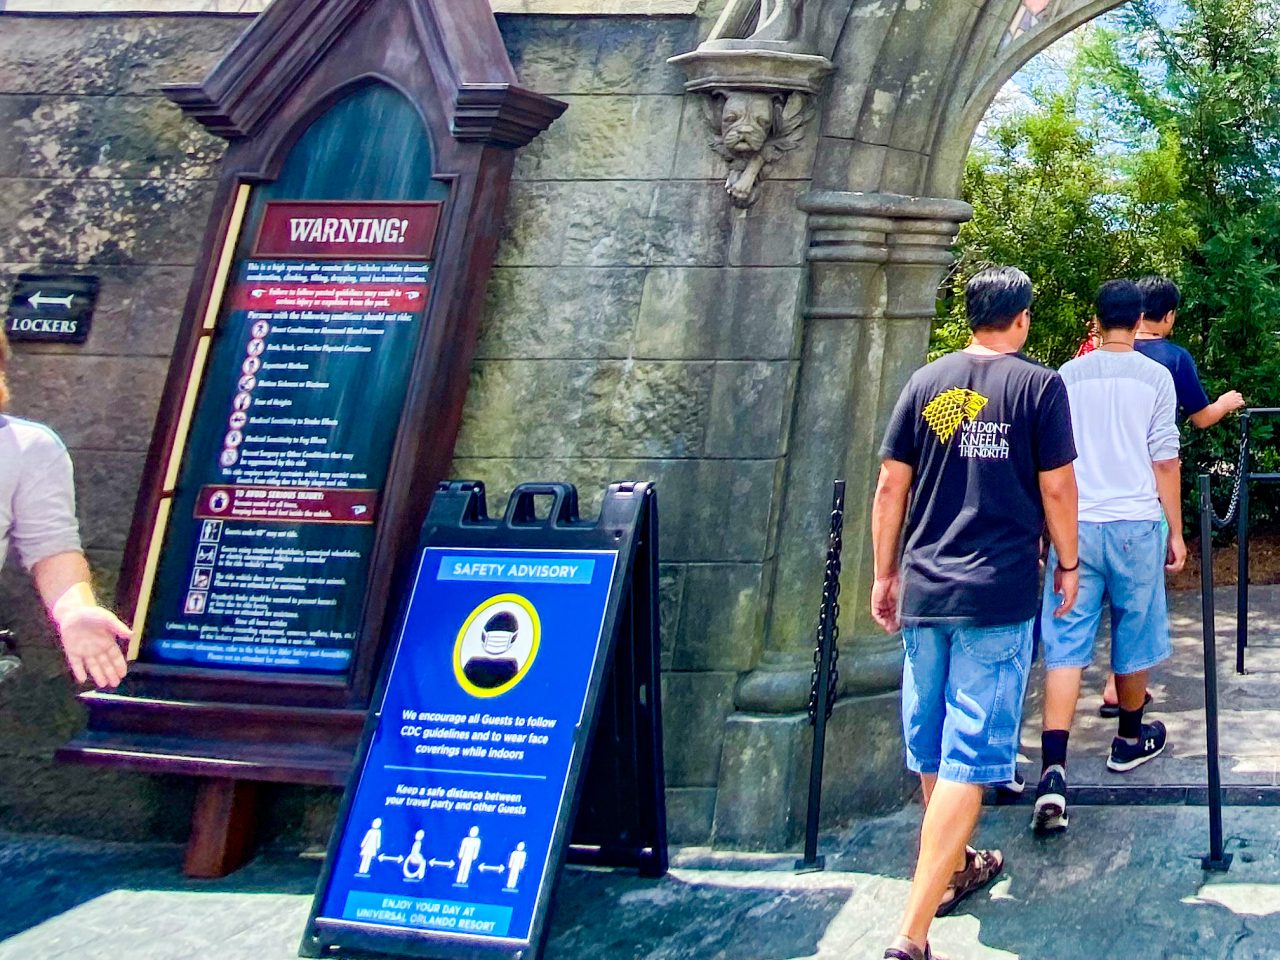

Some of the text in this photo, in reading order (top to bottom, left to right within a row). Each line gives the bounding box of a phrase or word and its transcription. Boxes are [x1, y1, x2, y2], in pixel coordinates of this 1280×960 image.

[289, 217, 409, 244] WARNING!
[11, 318, 78, 334] LOCKERS
[960, 432, 998, 447] KNEEL
[453, 563, 578, 578] SAFETY ADVISORY
[402, 710, 557, 728] We encourage all Guests to follow
[400, 725, 549, 744] CDC guidelines and to wear face
[415, 744, 524, 760] coverings while indoors
[396, 784, 521, 802] Keep a safe distance between
[385, 797, 526, 815] your travel party and other Guests
[382, 899, 475, 916] ENJOY YOUR DAY AT
[356, 908, 496, 932] UNIVERSAL ORLANDO RESORT
